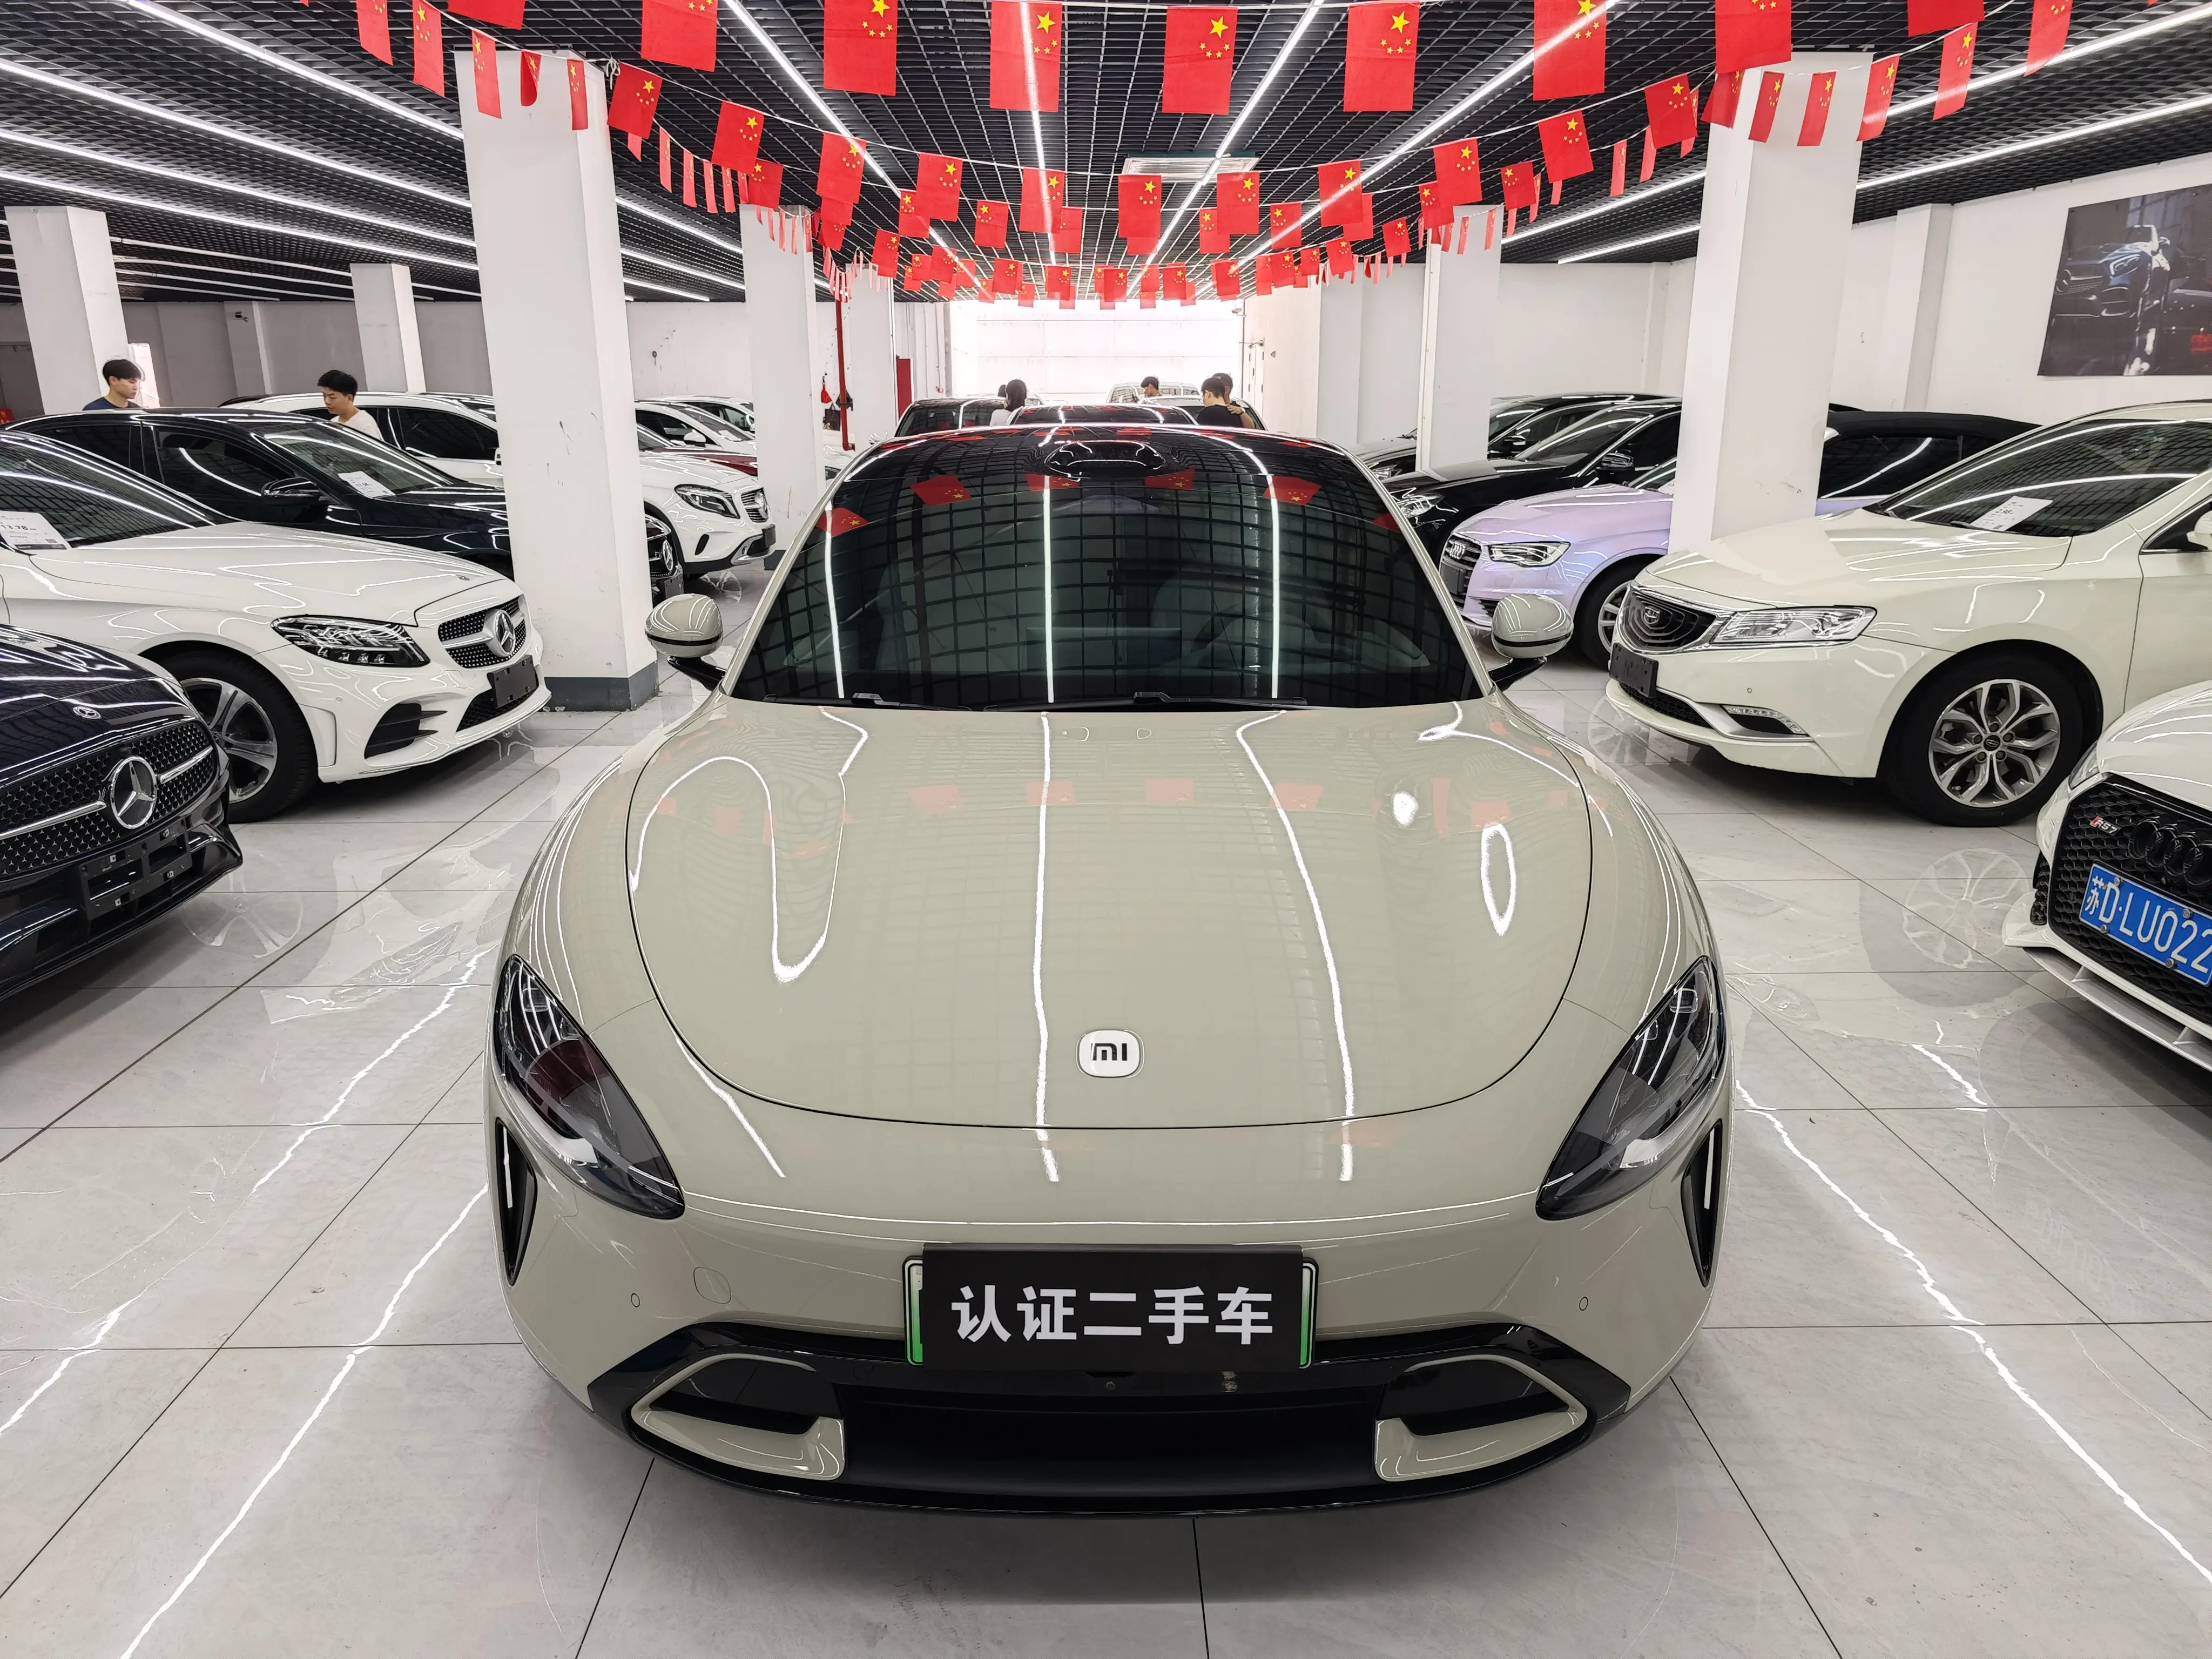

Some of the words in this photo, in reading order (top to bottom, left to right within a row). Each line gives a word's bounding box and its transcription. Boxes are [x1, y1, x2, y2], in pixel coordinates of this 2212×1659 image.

[2093, 819, 2118, 834] RS7
[951, 1284, 1273, 1345] 认证二手车
